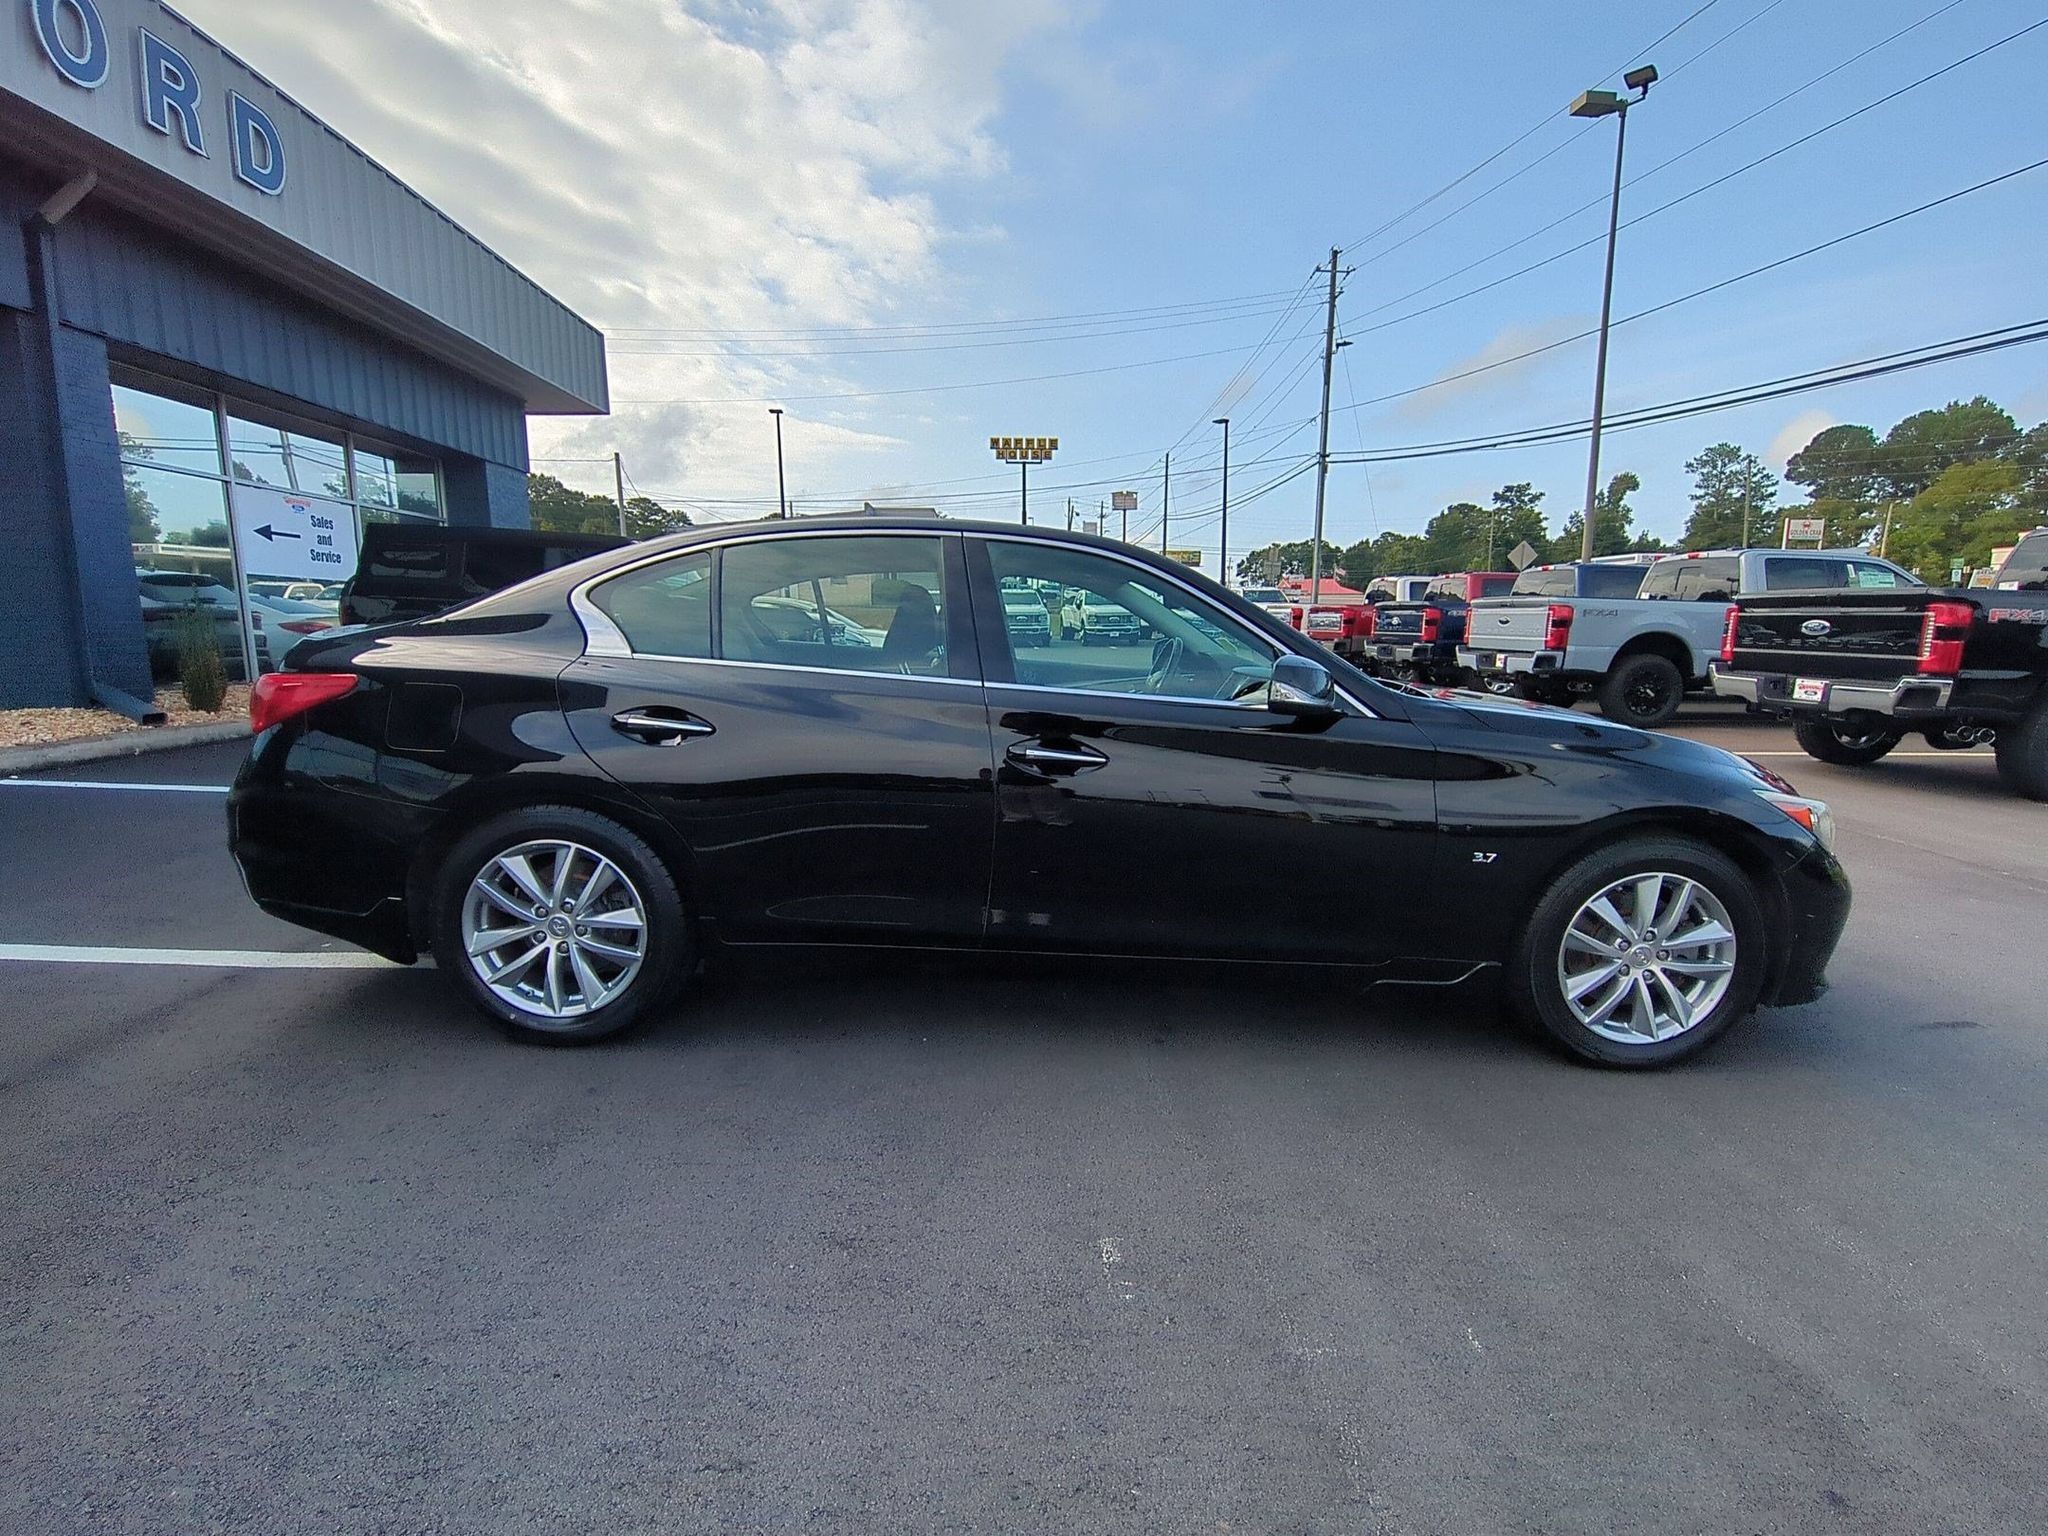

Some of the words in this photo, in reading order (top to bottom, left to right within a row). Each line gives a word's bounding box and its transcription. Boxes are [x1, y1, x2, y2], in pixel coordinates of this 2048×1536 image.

[990, 437, 1058, 449] WAFFLE
[997, 449, 1052, 459] HOUSE
[310, 515, 334, 530] Sales
[316, 534, 333, 546] and
[310, 549, 341, 564] Service
[1472, 852, 1497, 863] 3.7
